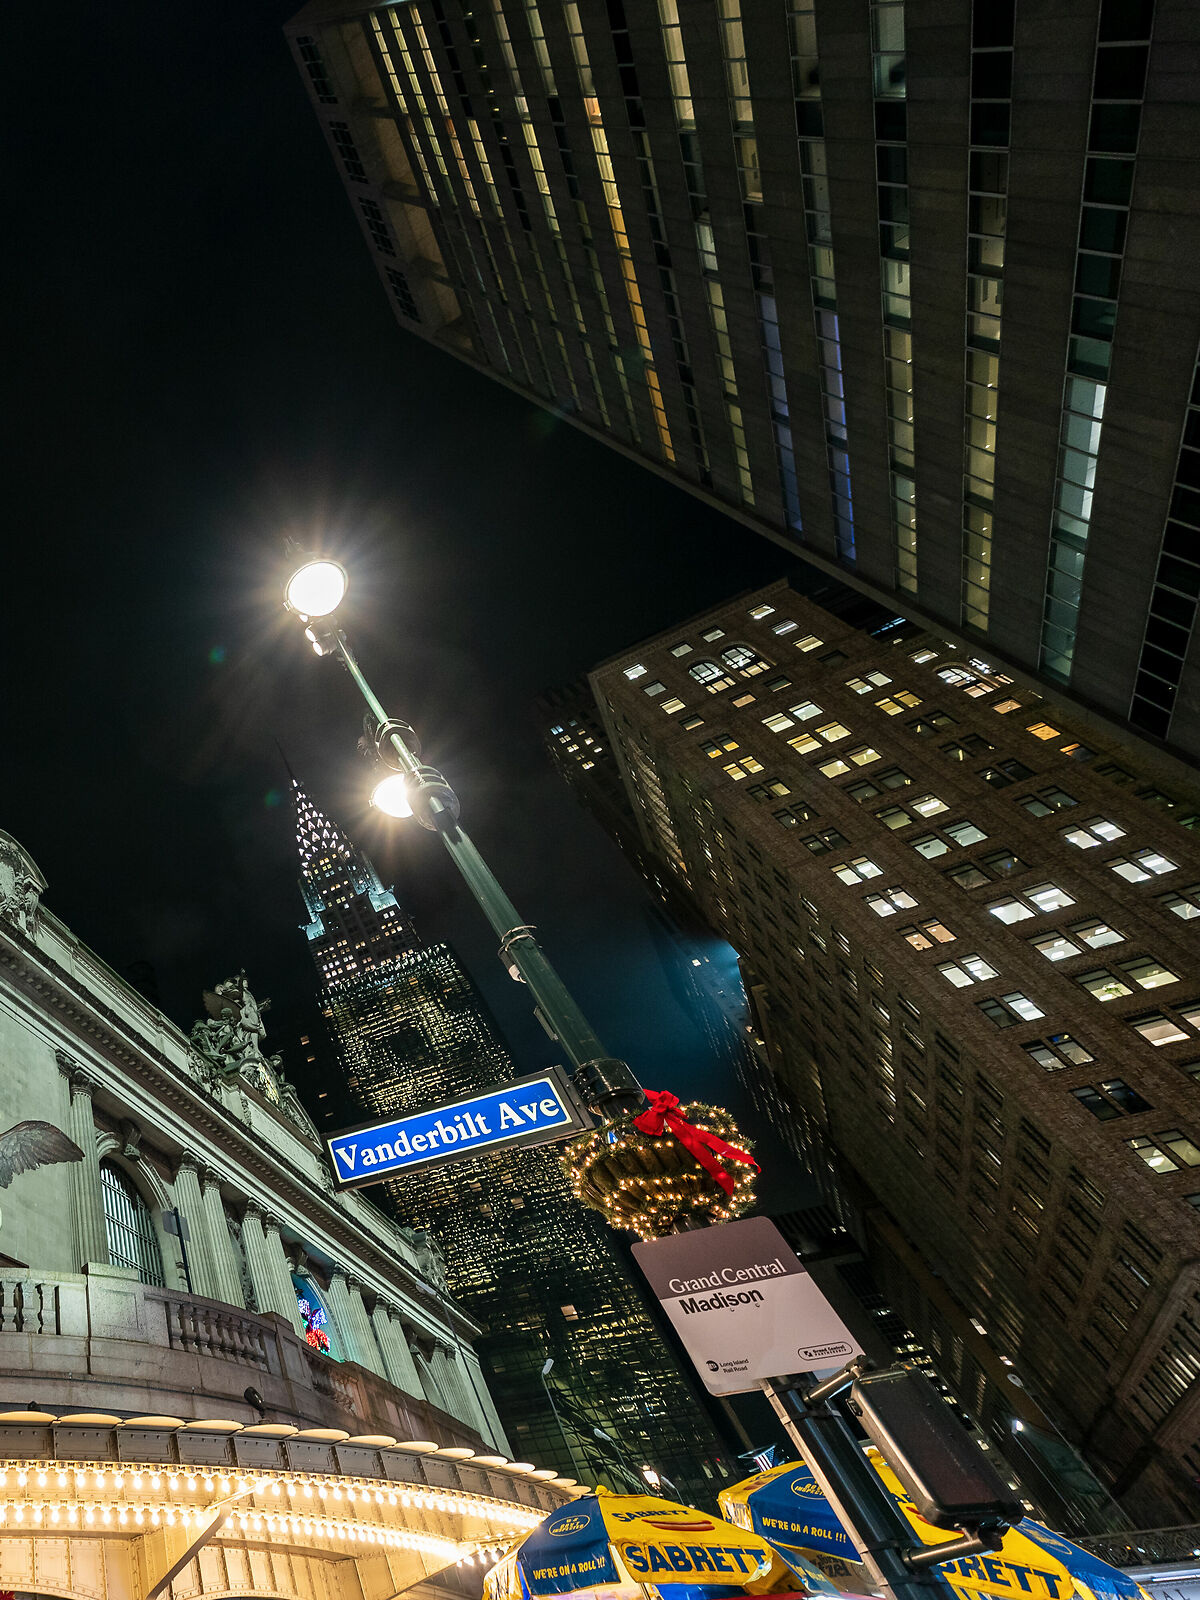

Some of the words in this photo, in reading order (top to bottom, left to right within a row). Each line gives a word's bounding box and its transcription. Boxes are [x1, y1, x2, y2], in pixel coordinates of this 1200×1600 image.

[334, 1112, 492, 1171] Vanderbilt
[499, 1098, 560, 1130] Ave
[668, 1271, 723, 1294] Grand
[721, 1258, 787, 1285] Central
[678, 1287, 765, 1315] Madison
[611, 1510, 689, 1523] SABRETT
[761, 1516, 789, 1531] WE'RE
[790, 1522, 801, 1533] ON
[802, 1525, 809, 1534] A
[810, 1526, 832, 1540] ROLL
[532, 1565, 558, 1580] WE'RE
[559, 1564, 571, 1576] ON
[570, 1563, 577, 1574] A
[578, 1559, 596, 1573] ROLL
[623, 1543, 767, 1574] SABRETT
[939, 1555, 1063, 1600] RETT
